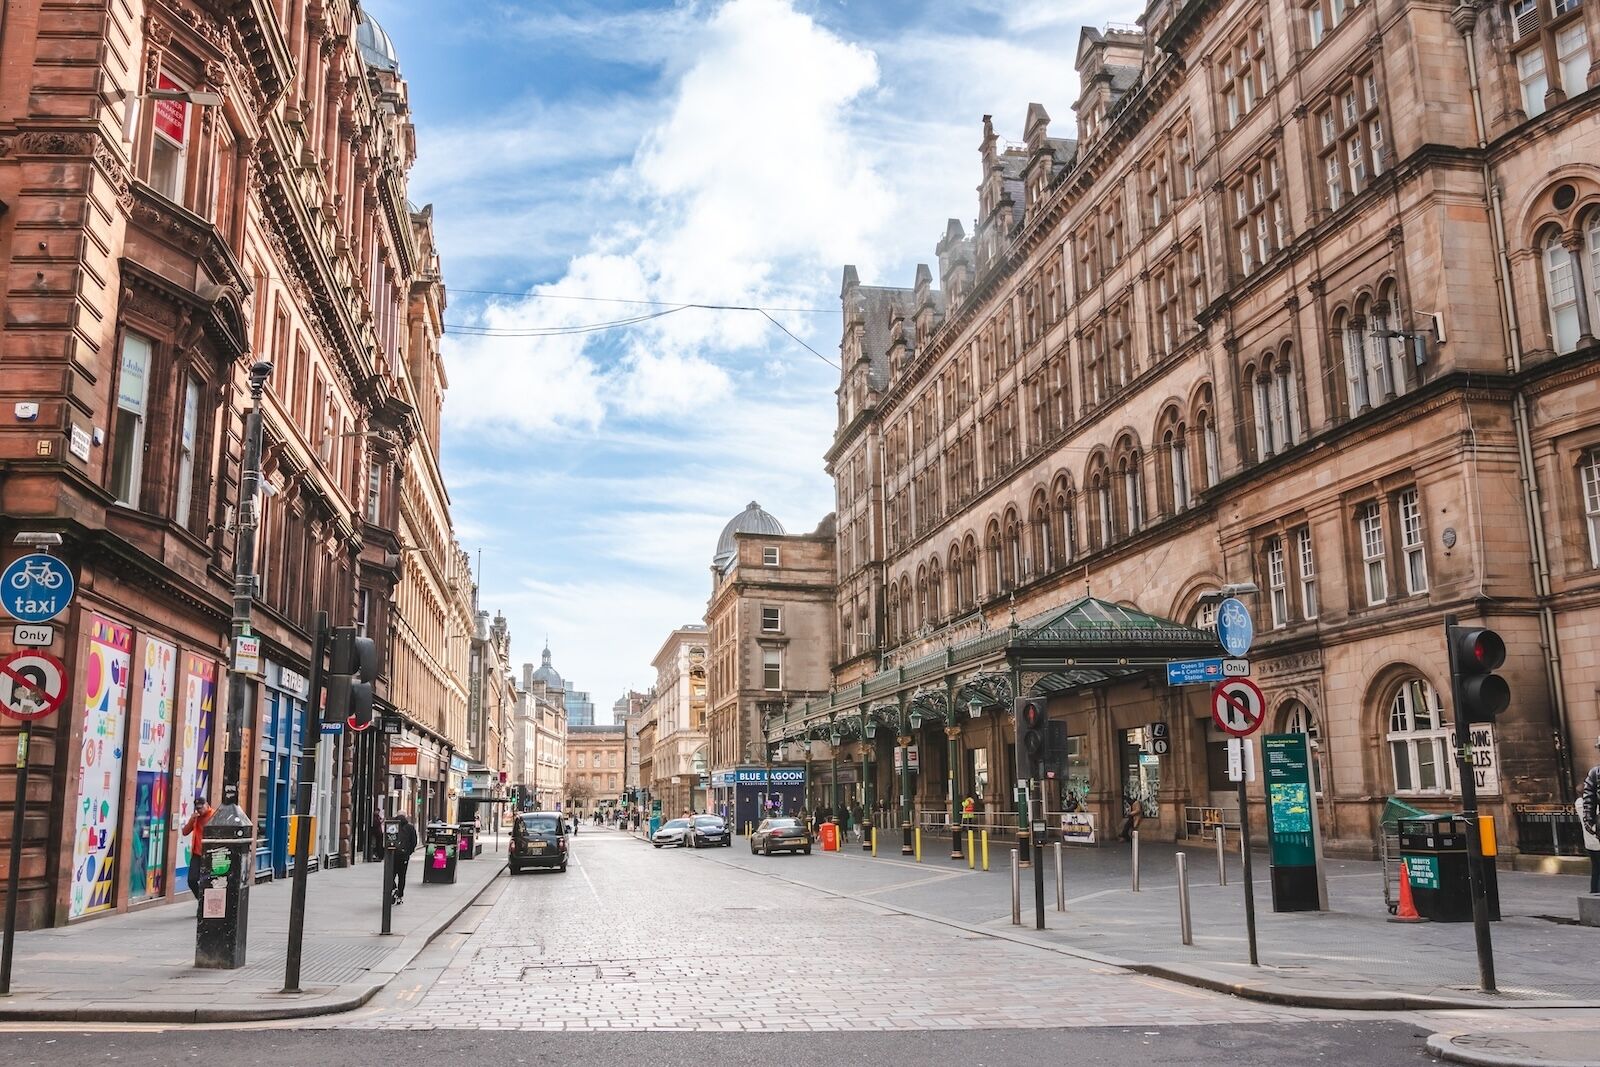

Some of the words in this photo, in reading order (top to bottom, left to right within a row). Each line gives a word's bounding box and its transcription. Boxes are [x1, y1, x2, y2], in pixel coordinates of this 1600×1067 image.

[15, 596, 56, 614] taxi
[20, 631, 48, 641] Only
[1226, 635, 1246, 649] taxi
[243, 643, 257, 652] CCTV
[1226, 664, 1246, 672] Only
[764, 772, 803, 780] LAGOON
